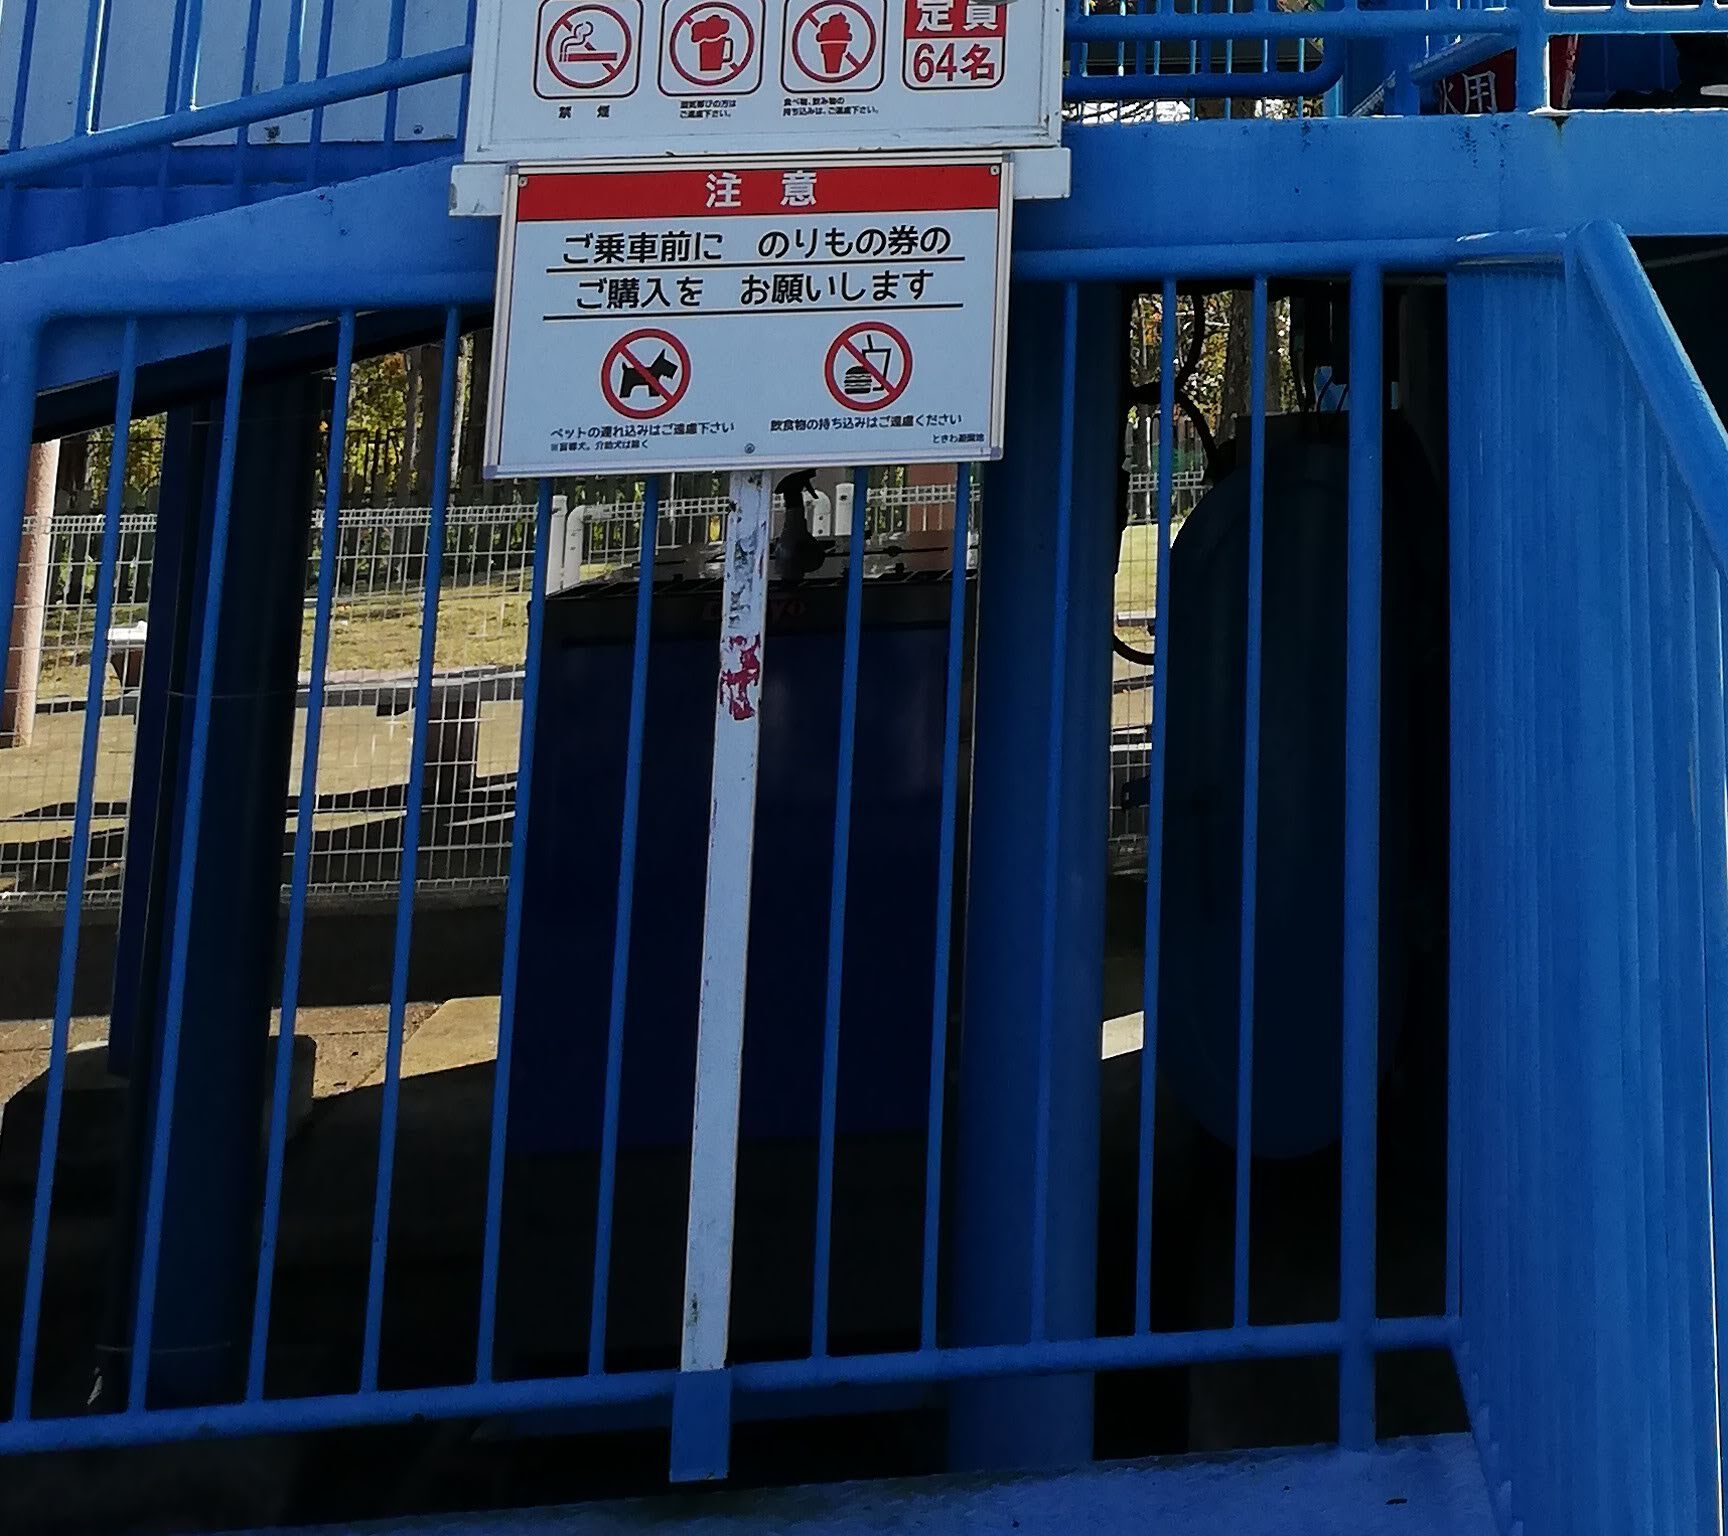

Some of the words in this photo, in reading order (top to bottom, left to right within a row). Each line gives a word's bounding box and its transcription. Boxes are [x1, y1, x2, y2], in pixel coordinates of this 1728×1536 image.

[913, 43, 996, 83] 64名
[705, 170, 818, 209] 注意
[562, 230, 724, 265] ご乗車前に
[757, 225, 952, 259] のりもの券の
[576, 275, 704, 310] ご購入を
[740, 268, 935, 305] お願いします
